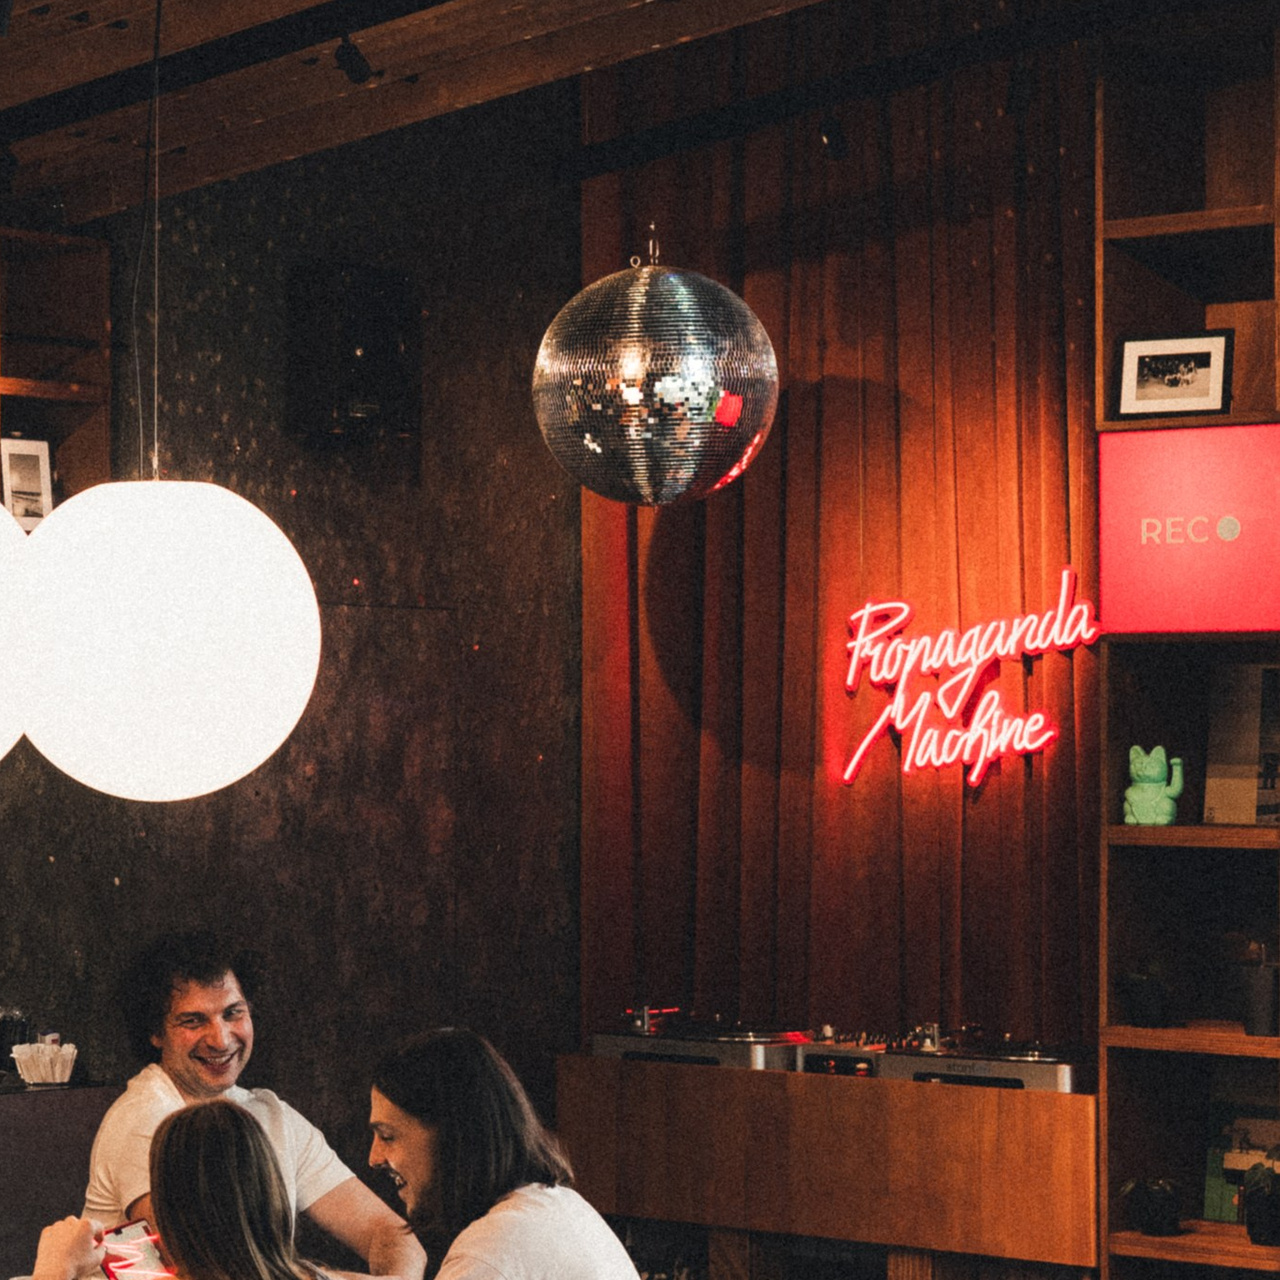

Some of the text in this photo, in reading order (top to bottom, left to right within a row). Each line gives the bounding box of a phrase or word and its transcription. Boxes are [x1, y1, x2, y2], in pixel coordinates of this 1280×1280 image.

[1140, 517, 1209, 545] REC
[845, 567, 1098, 719] Propaganda
[842, 689, 1058, 784] Machine
